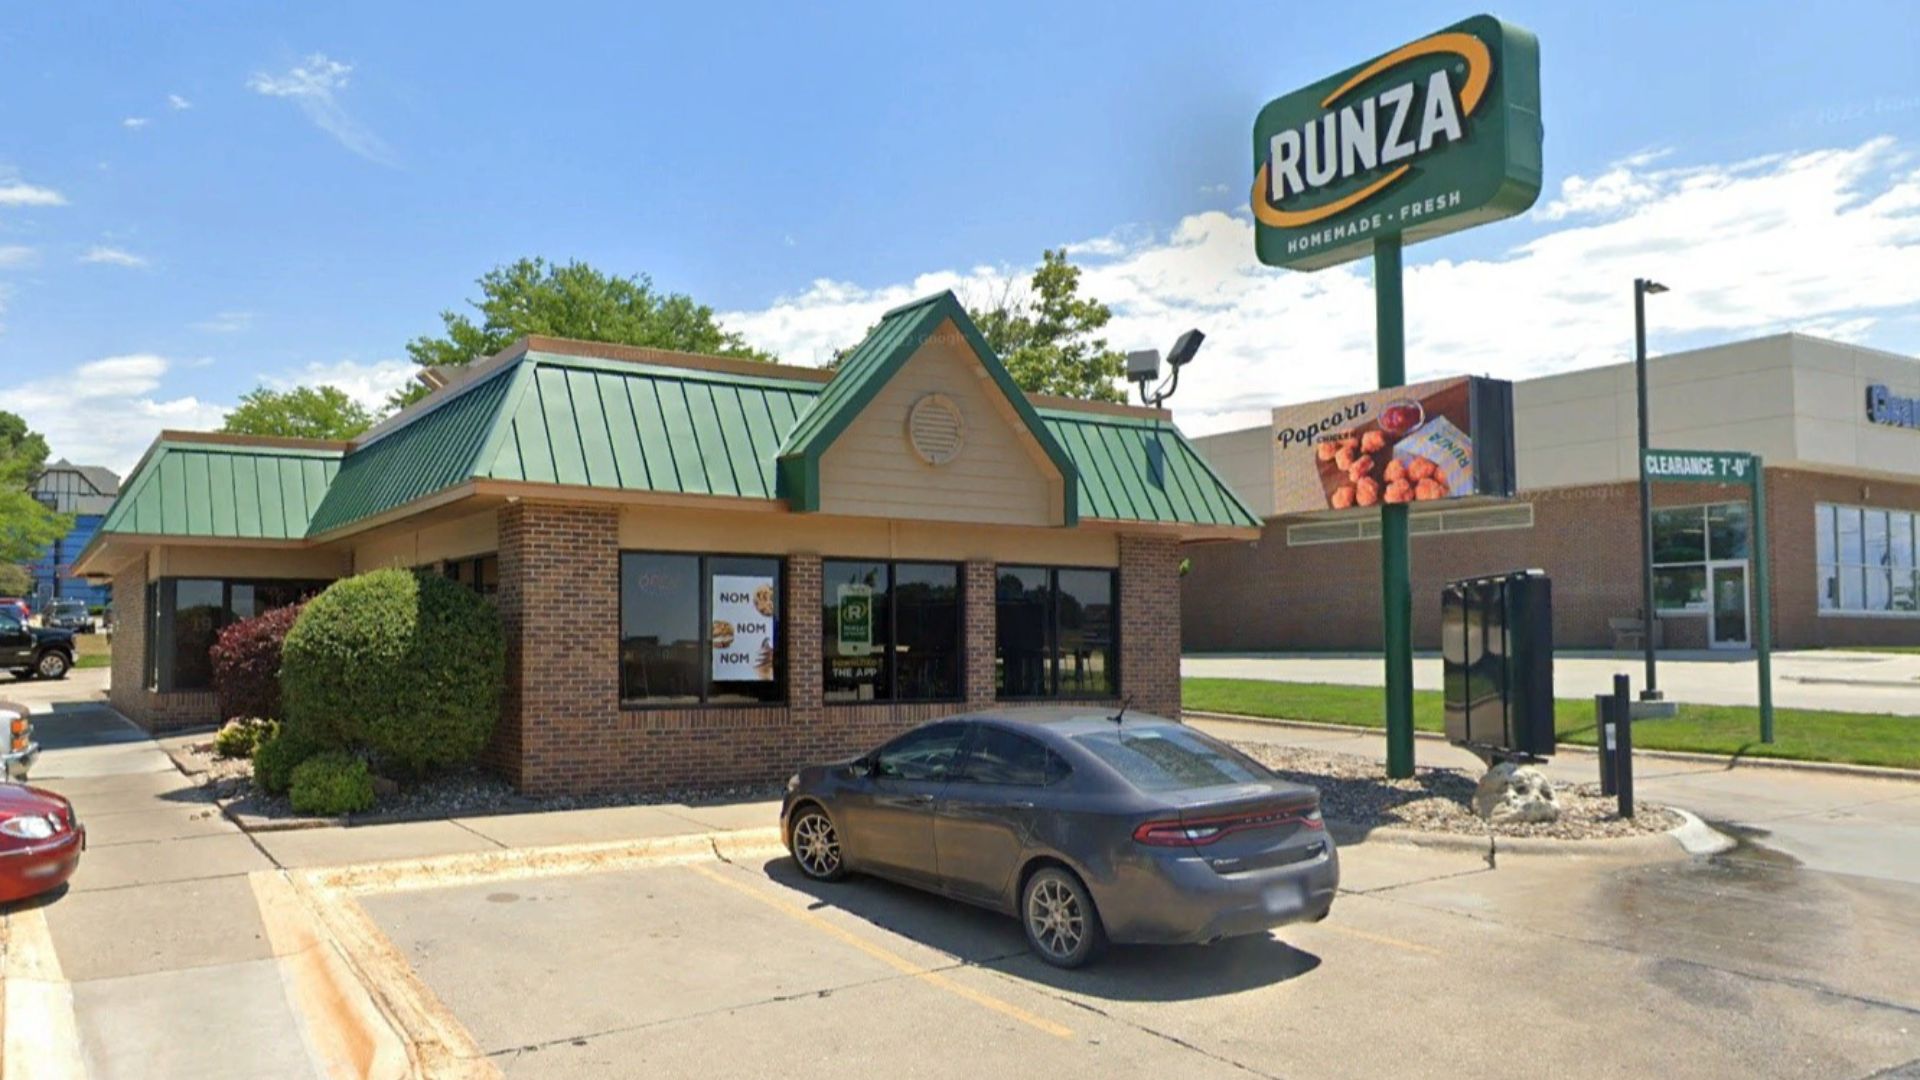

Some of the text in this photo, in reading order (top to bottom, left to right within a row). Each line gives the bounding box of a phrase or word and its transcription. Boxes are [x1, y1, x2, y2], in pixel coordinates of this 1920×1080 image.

[1270, 69, 1462, 201] RUNZA
[1288, 190, 1461, 253] HOMEMADE FRESH
[1277, 400, 1368, 449] Popcorn
[1645, 454, 1715, 476] CLEARANCE
[720, 592, 750, 604] NOM
[736, 623, 766, 634] NOM
[720, 653, 750, 664] NOM
[833, 668, 877, 678] THE APP
